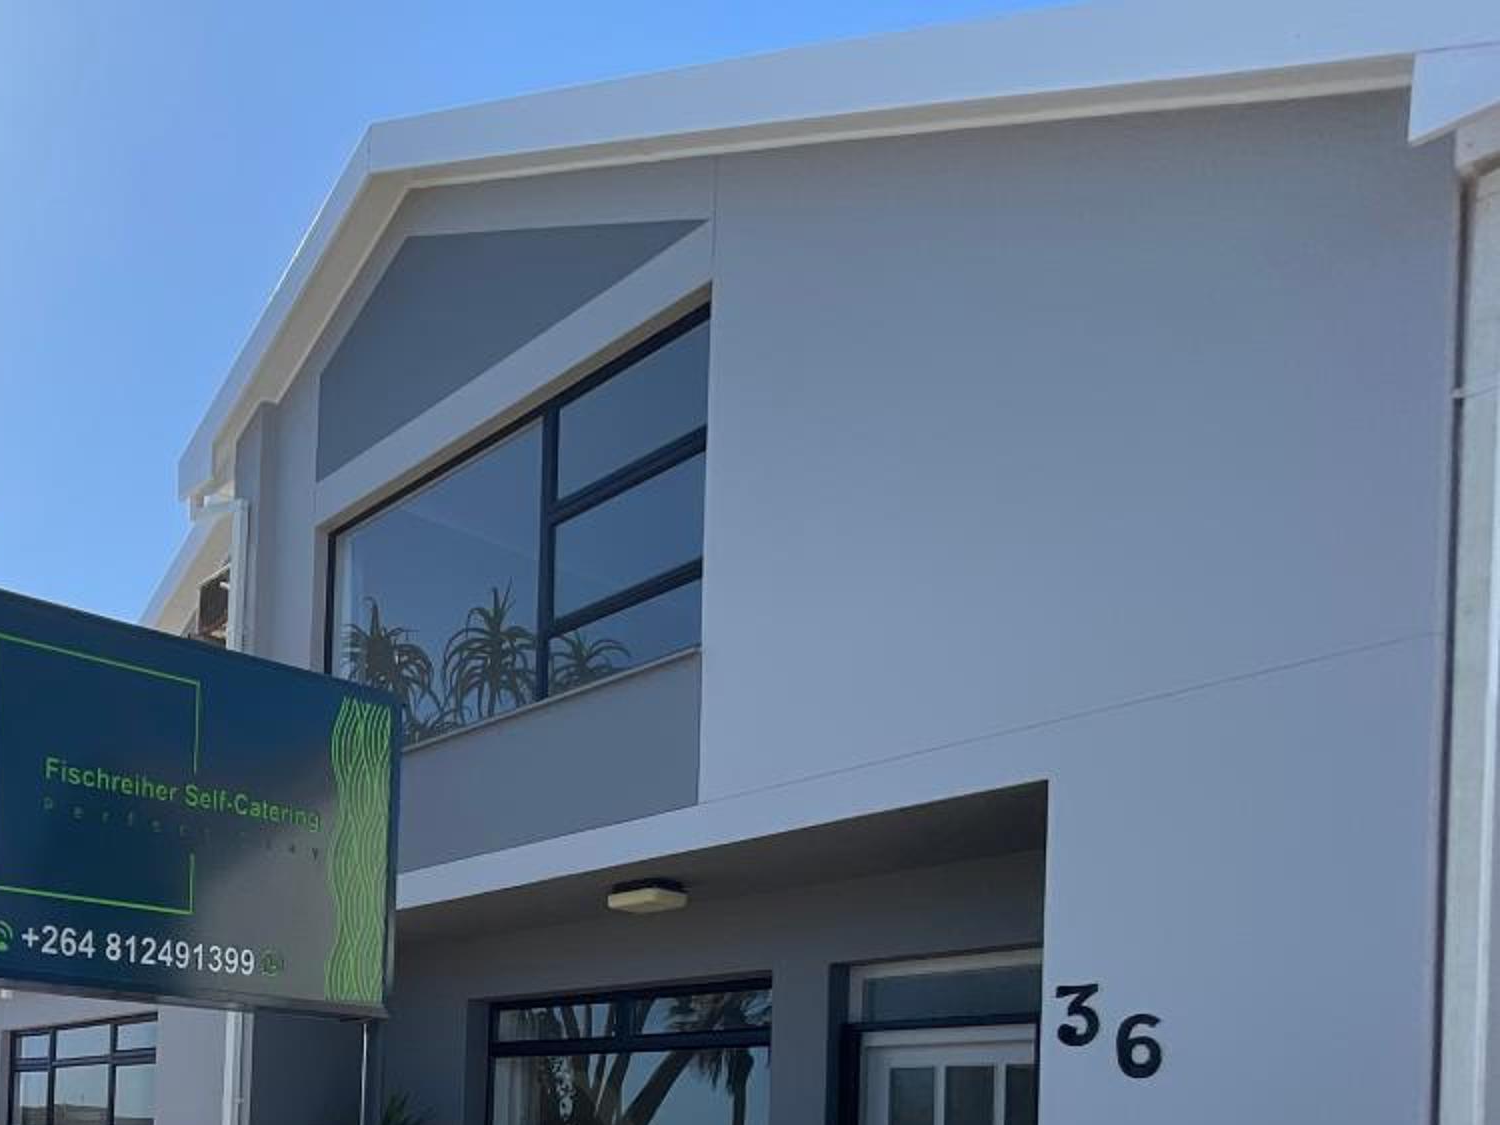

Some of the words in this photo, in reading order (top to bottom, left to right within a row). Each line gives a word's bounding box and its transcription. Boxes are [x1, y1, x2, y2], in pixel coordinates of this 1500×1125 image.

[45, 756, 177, 801] Fischreiher
[184, 784, 320, 833] Self-Catering
[21, 925, 96, 959] +264
[105, 933, 256, 976] 812491399
[1056, 983, 1163, 1079] 36
